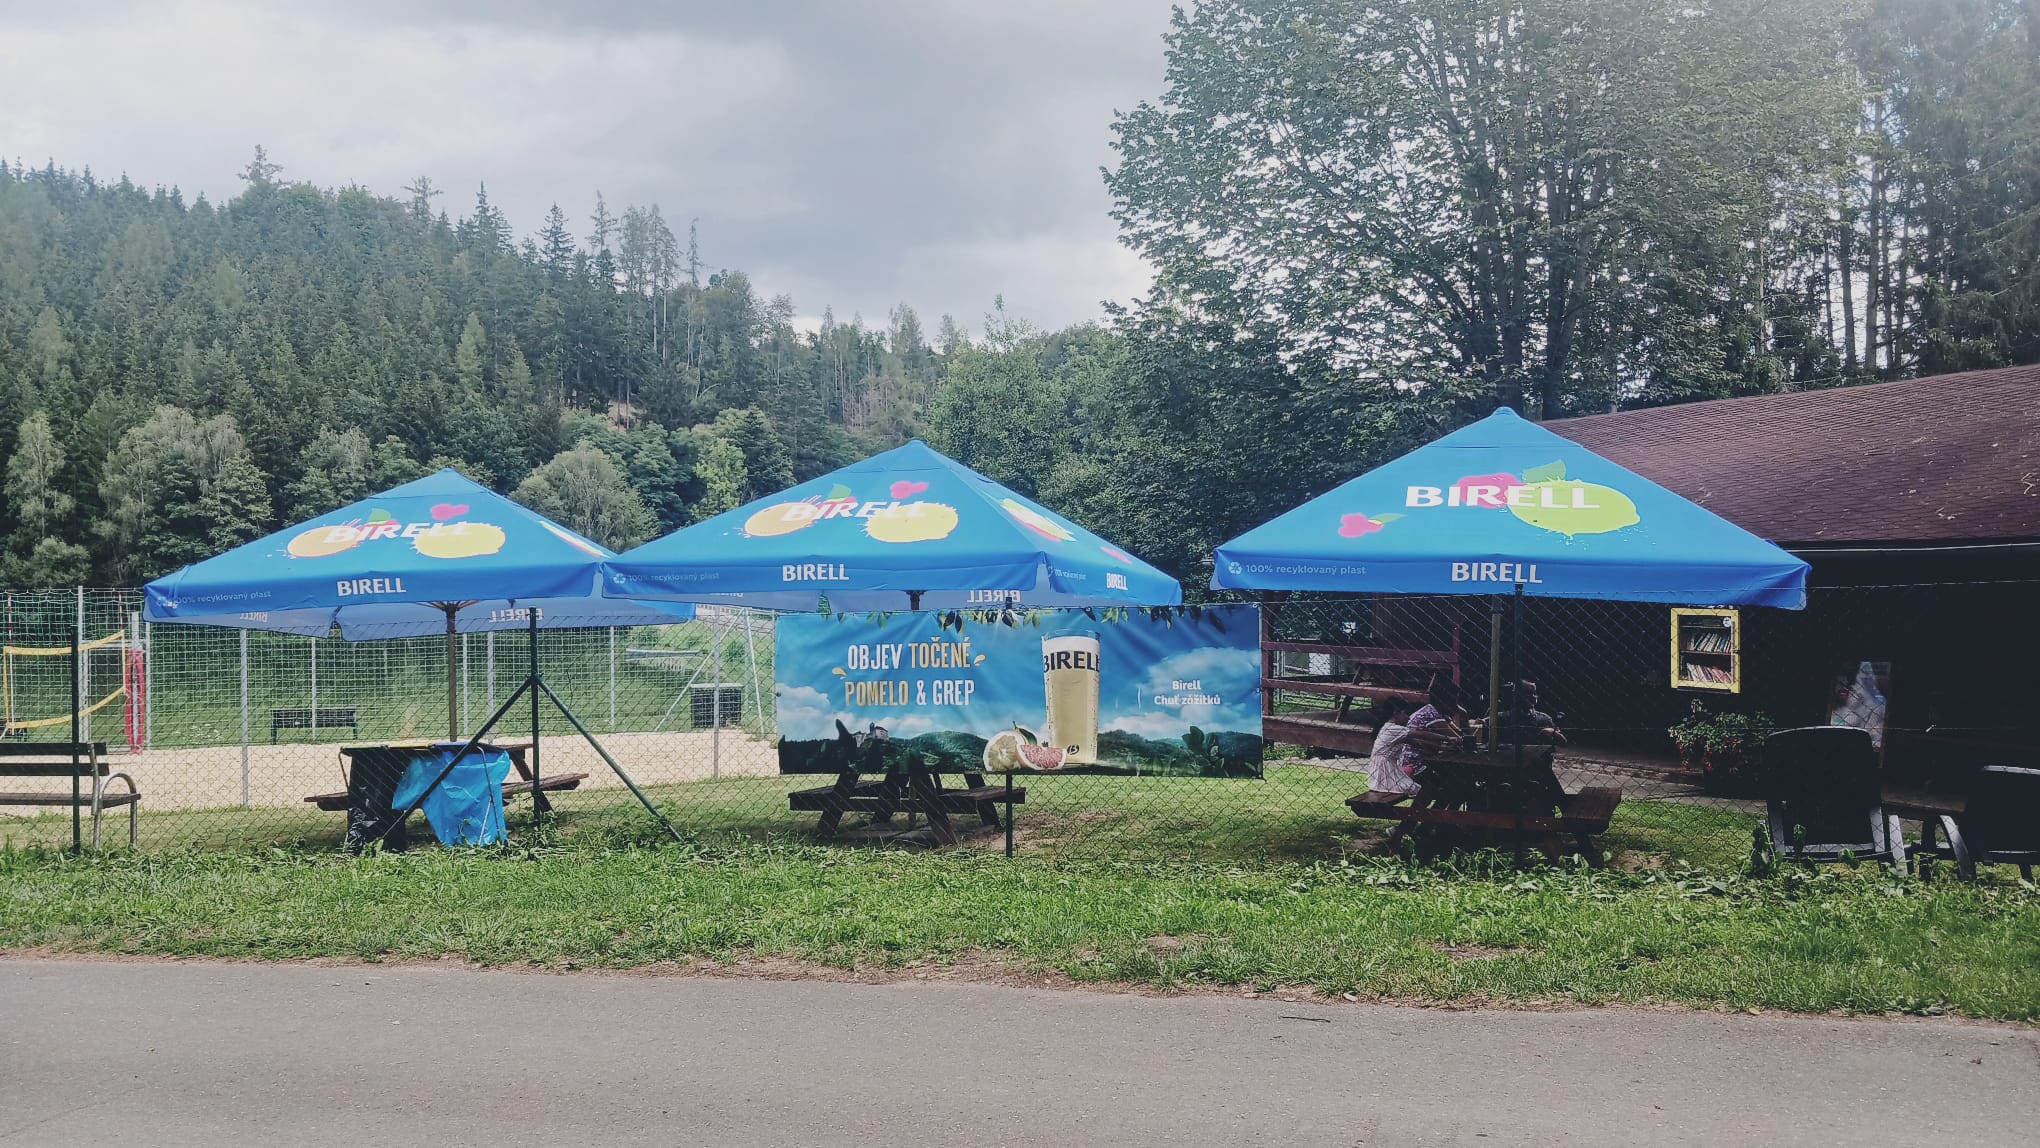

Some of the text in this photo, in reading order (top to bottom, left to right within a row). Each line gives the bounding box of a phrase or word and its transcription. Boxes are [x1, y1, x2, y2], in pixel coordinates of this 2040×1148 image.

[1405, 485, 1600, 508] BIRELL
[781, 500, 927, 521] BIRELL
[324, 522, 473, 543] BIRELL
[782, 563, 849, 582] BIRELL
[1246, 565, 1366, 575] 100% recyklovaný plast
[1451, 562, 1543, 583] BIRELL
[336, 577, 407, 596] BIRELL
[1106, 572, 1129, 591] BIRELL
[847, 636, 971, 670] OBJEV TOČENÉ
[845, 679, 975, 706] POMELO & GREP
[1172, 679, 1201, 690] Birell
[1153, 693, 1180, 705] Chuť
